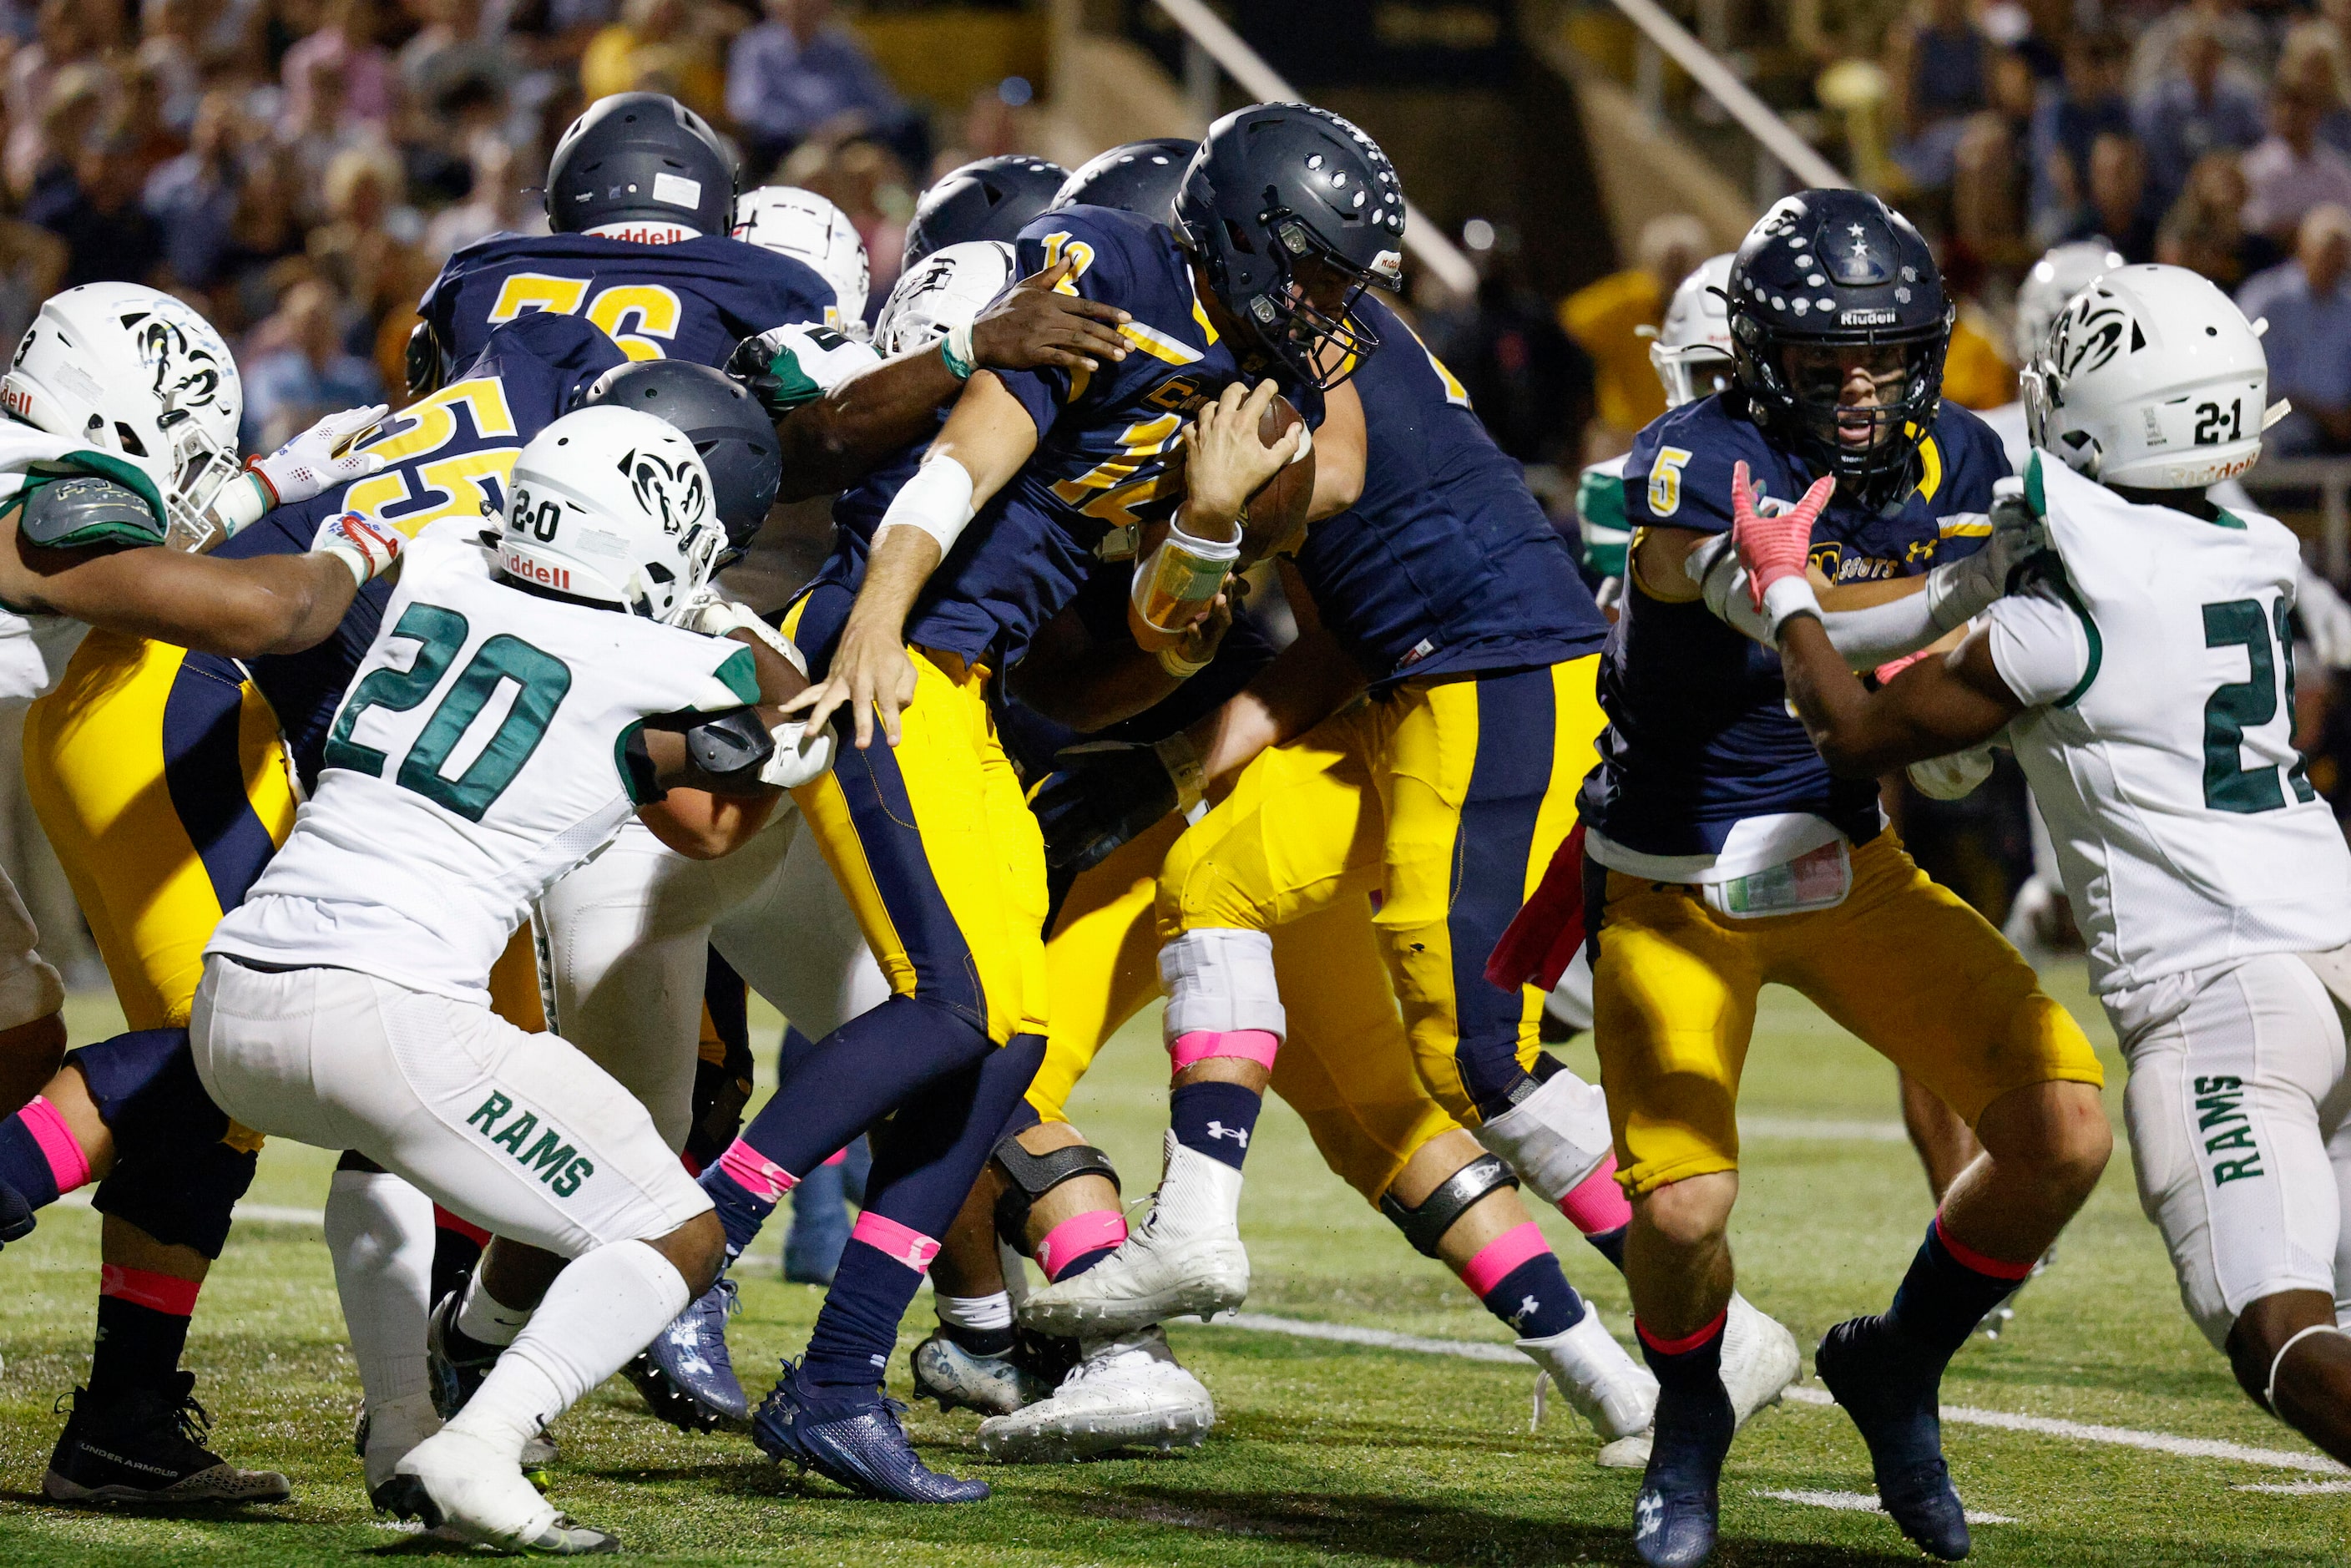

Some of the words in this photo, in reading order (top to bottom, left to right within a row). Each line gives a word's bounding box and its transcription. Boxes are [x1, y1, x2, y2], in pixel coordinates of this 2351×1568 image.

[1647, 445, 1693, 517] 5
[324, 601, 572, 823] 20
[466, 1089, 595, 1198] RAMS
[2193, 1075, 2265, 1189] RAMS
[79, 1442, 123, 1464] UNDER
[124, 1459, 179, 1478] ARMOUR
